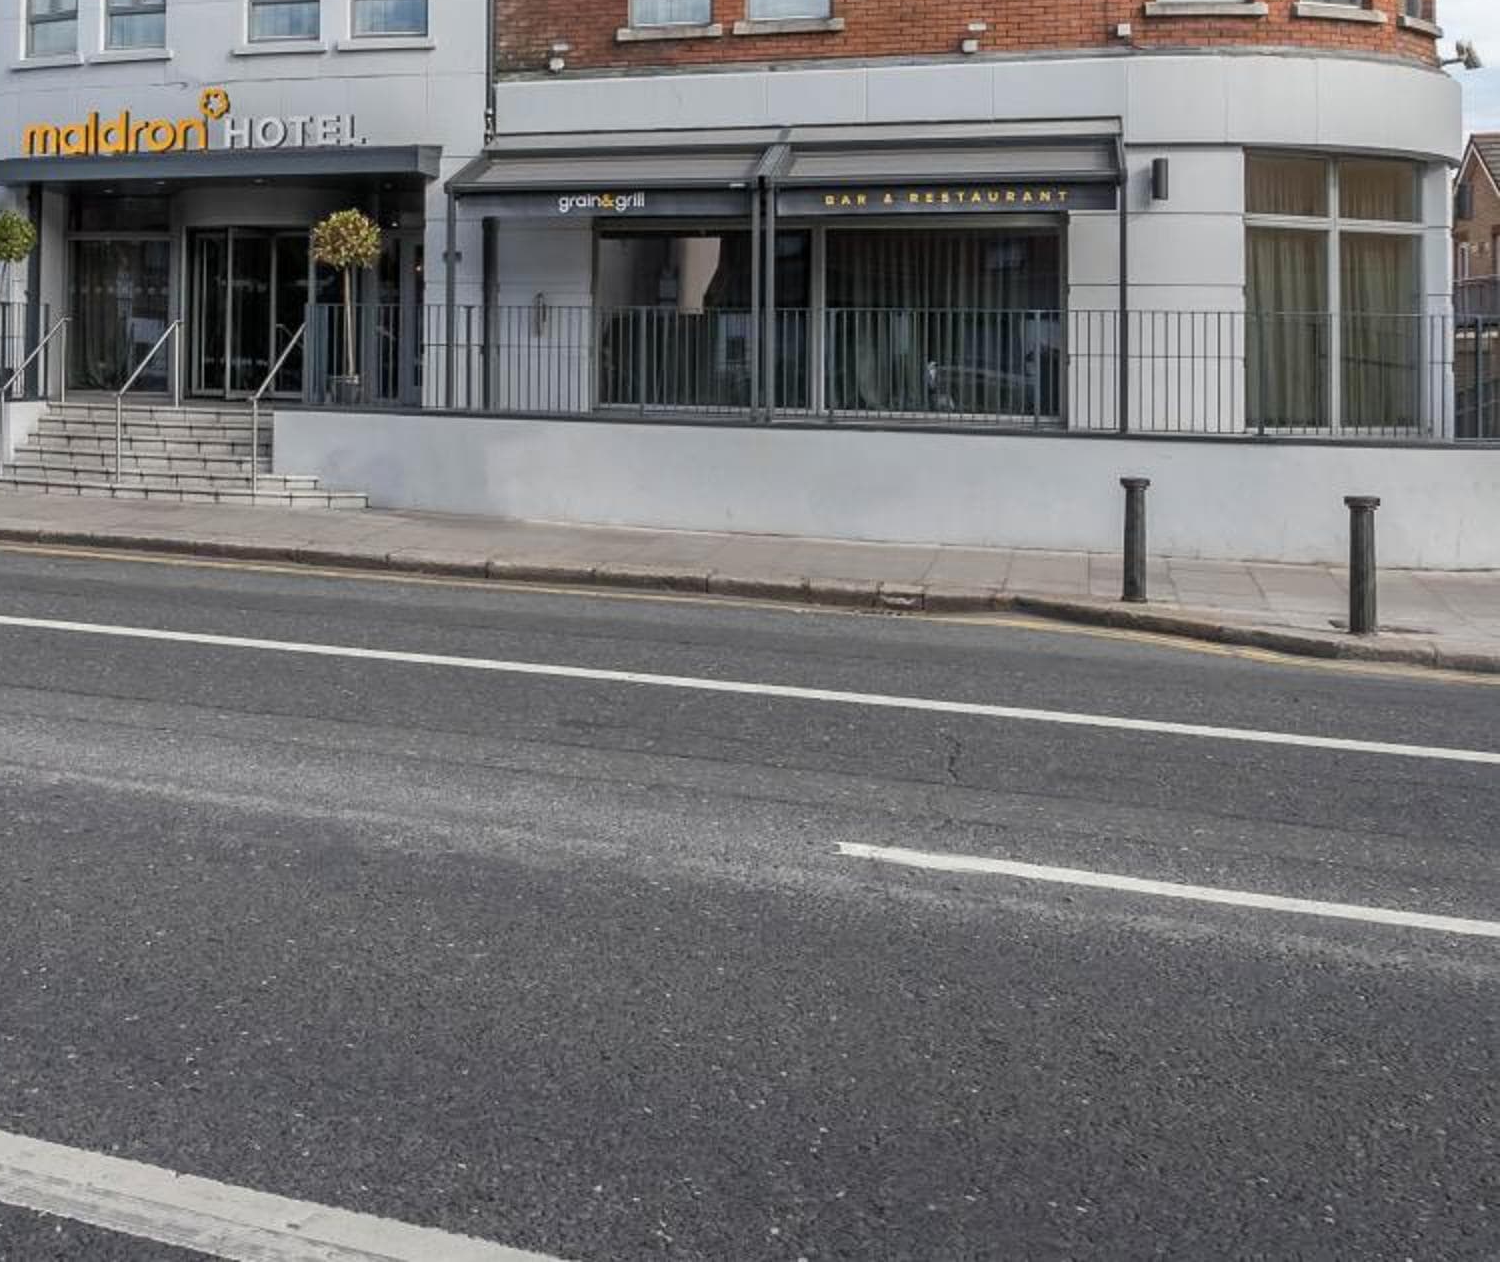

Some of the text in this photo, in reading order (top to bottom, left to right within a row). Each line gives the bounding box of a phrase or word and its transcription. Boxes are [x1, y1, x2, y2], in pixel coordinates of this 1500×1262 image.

[23, 109, 368, 155] maldron HOTEL
[825, 190, 1068, 206] BAR & RESTAURANT
